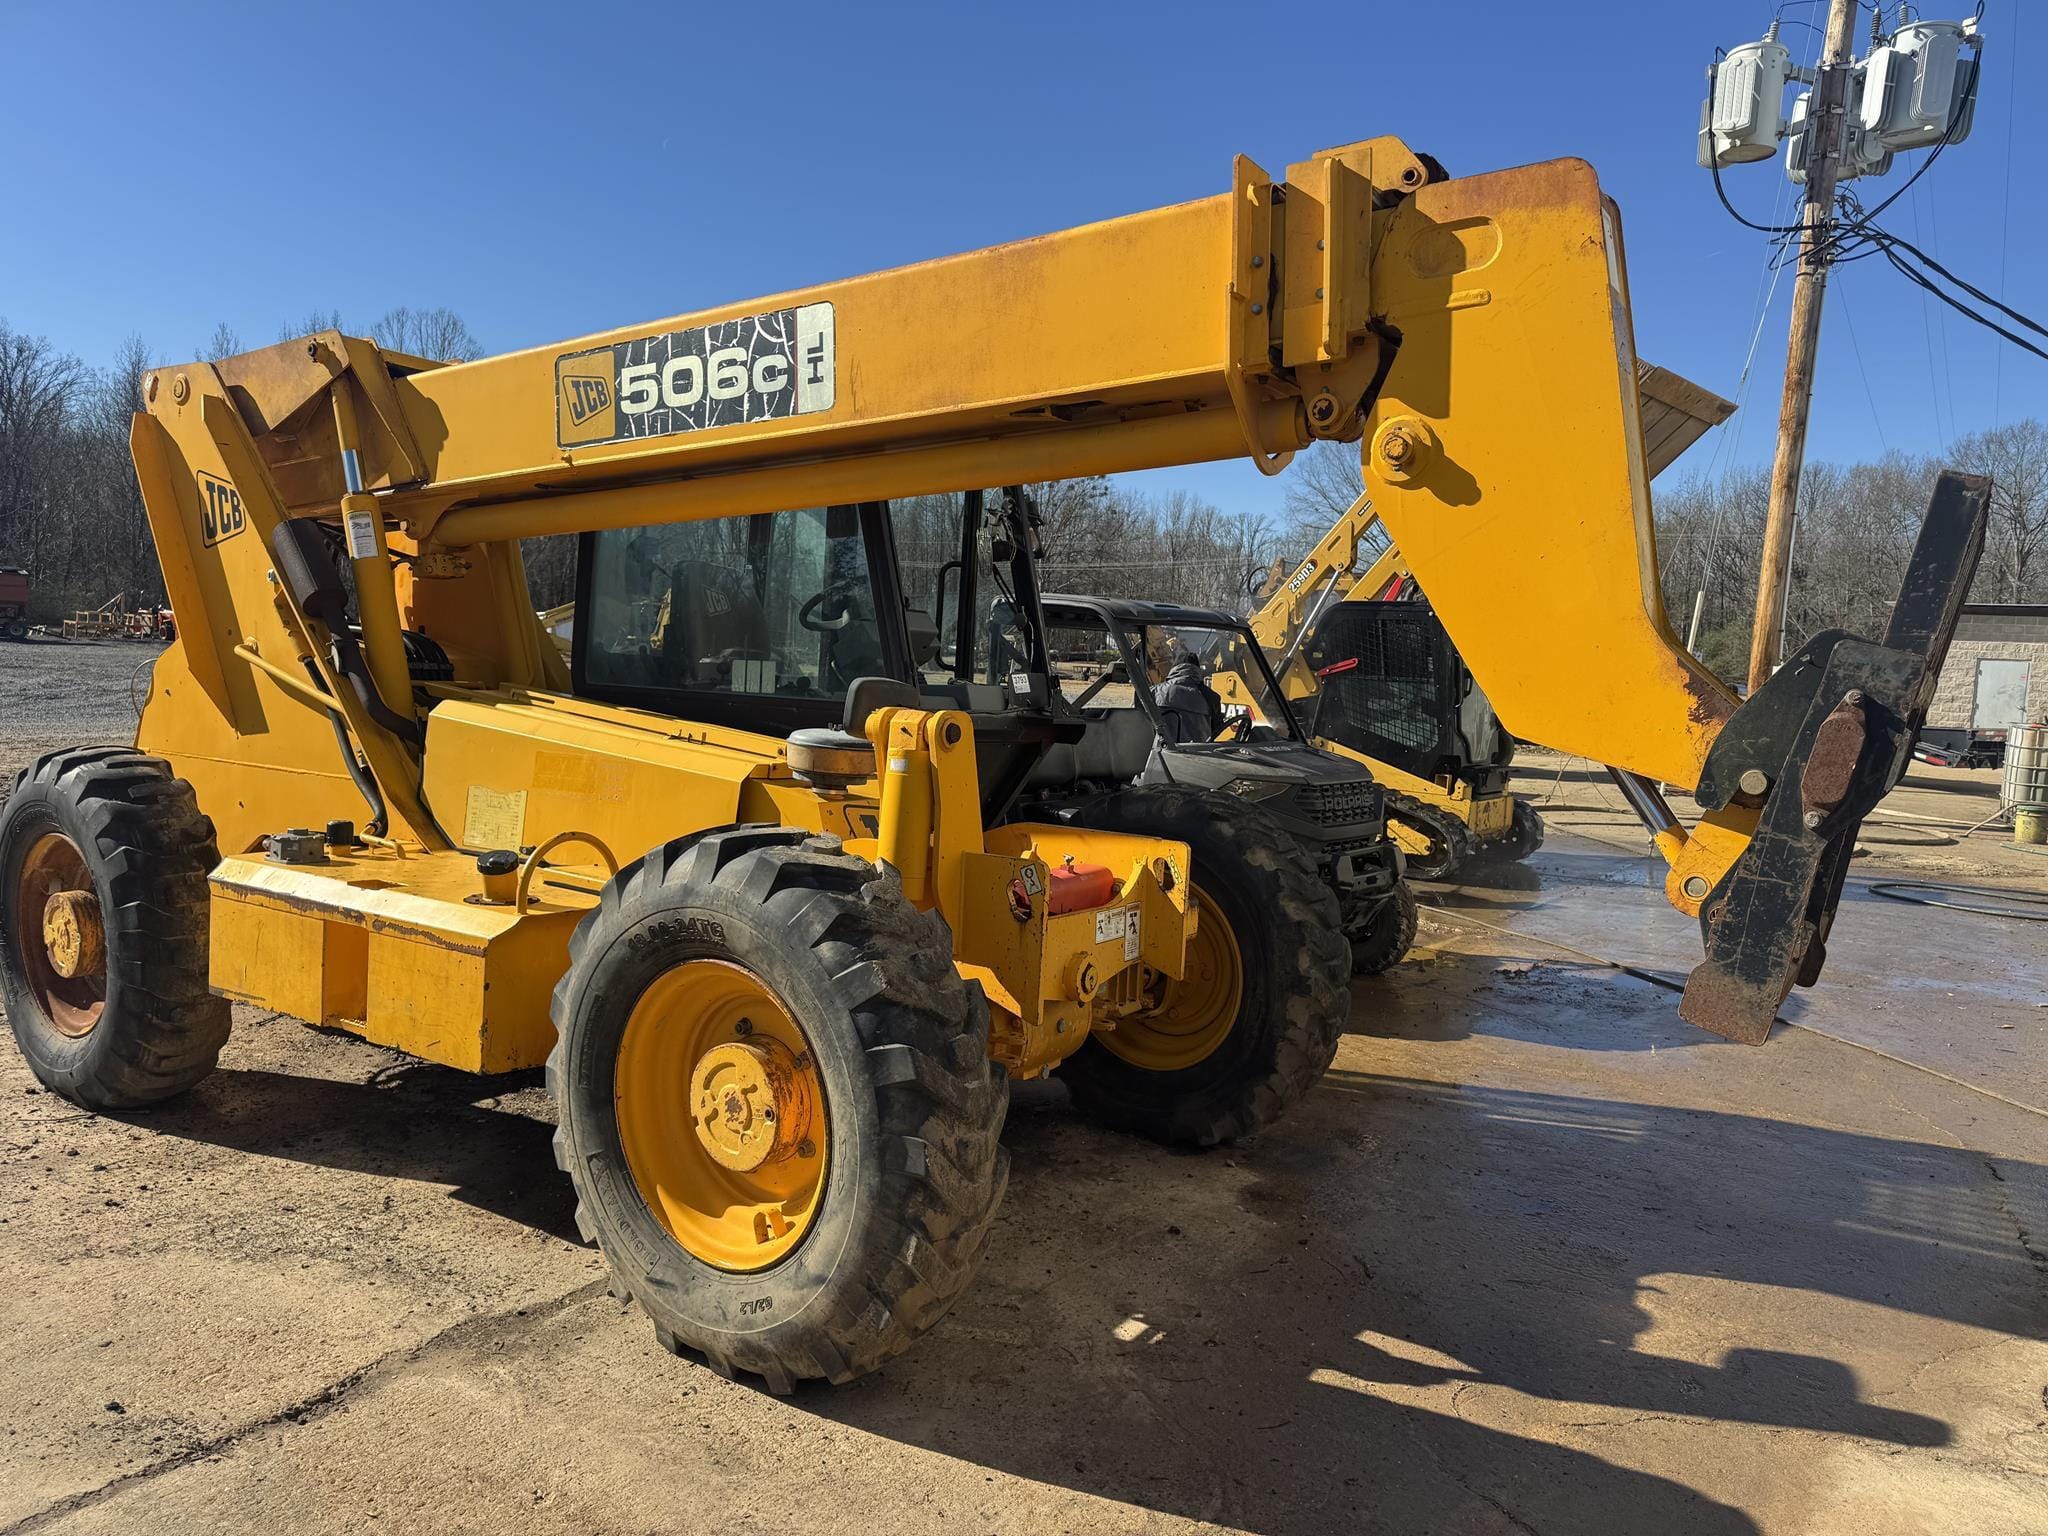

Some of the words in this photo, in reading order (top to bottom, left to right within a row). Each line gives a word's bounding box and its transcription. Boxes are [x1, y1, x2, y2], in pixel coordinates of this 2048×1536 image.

[571, 379, 609, 420] JCB
[204, 479, 243, 539] JCB
[1288, 562, 1315, 593] 259D3
